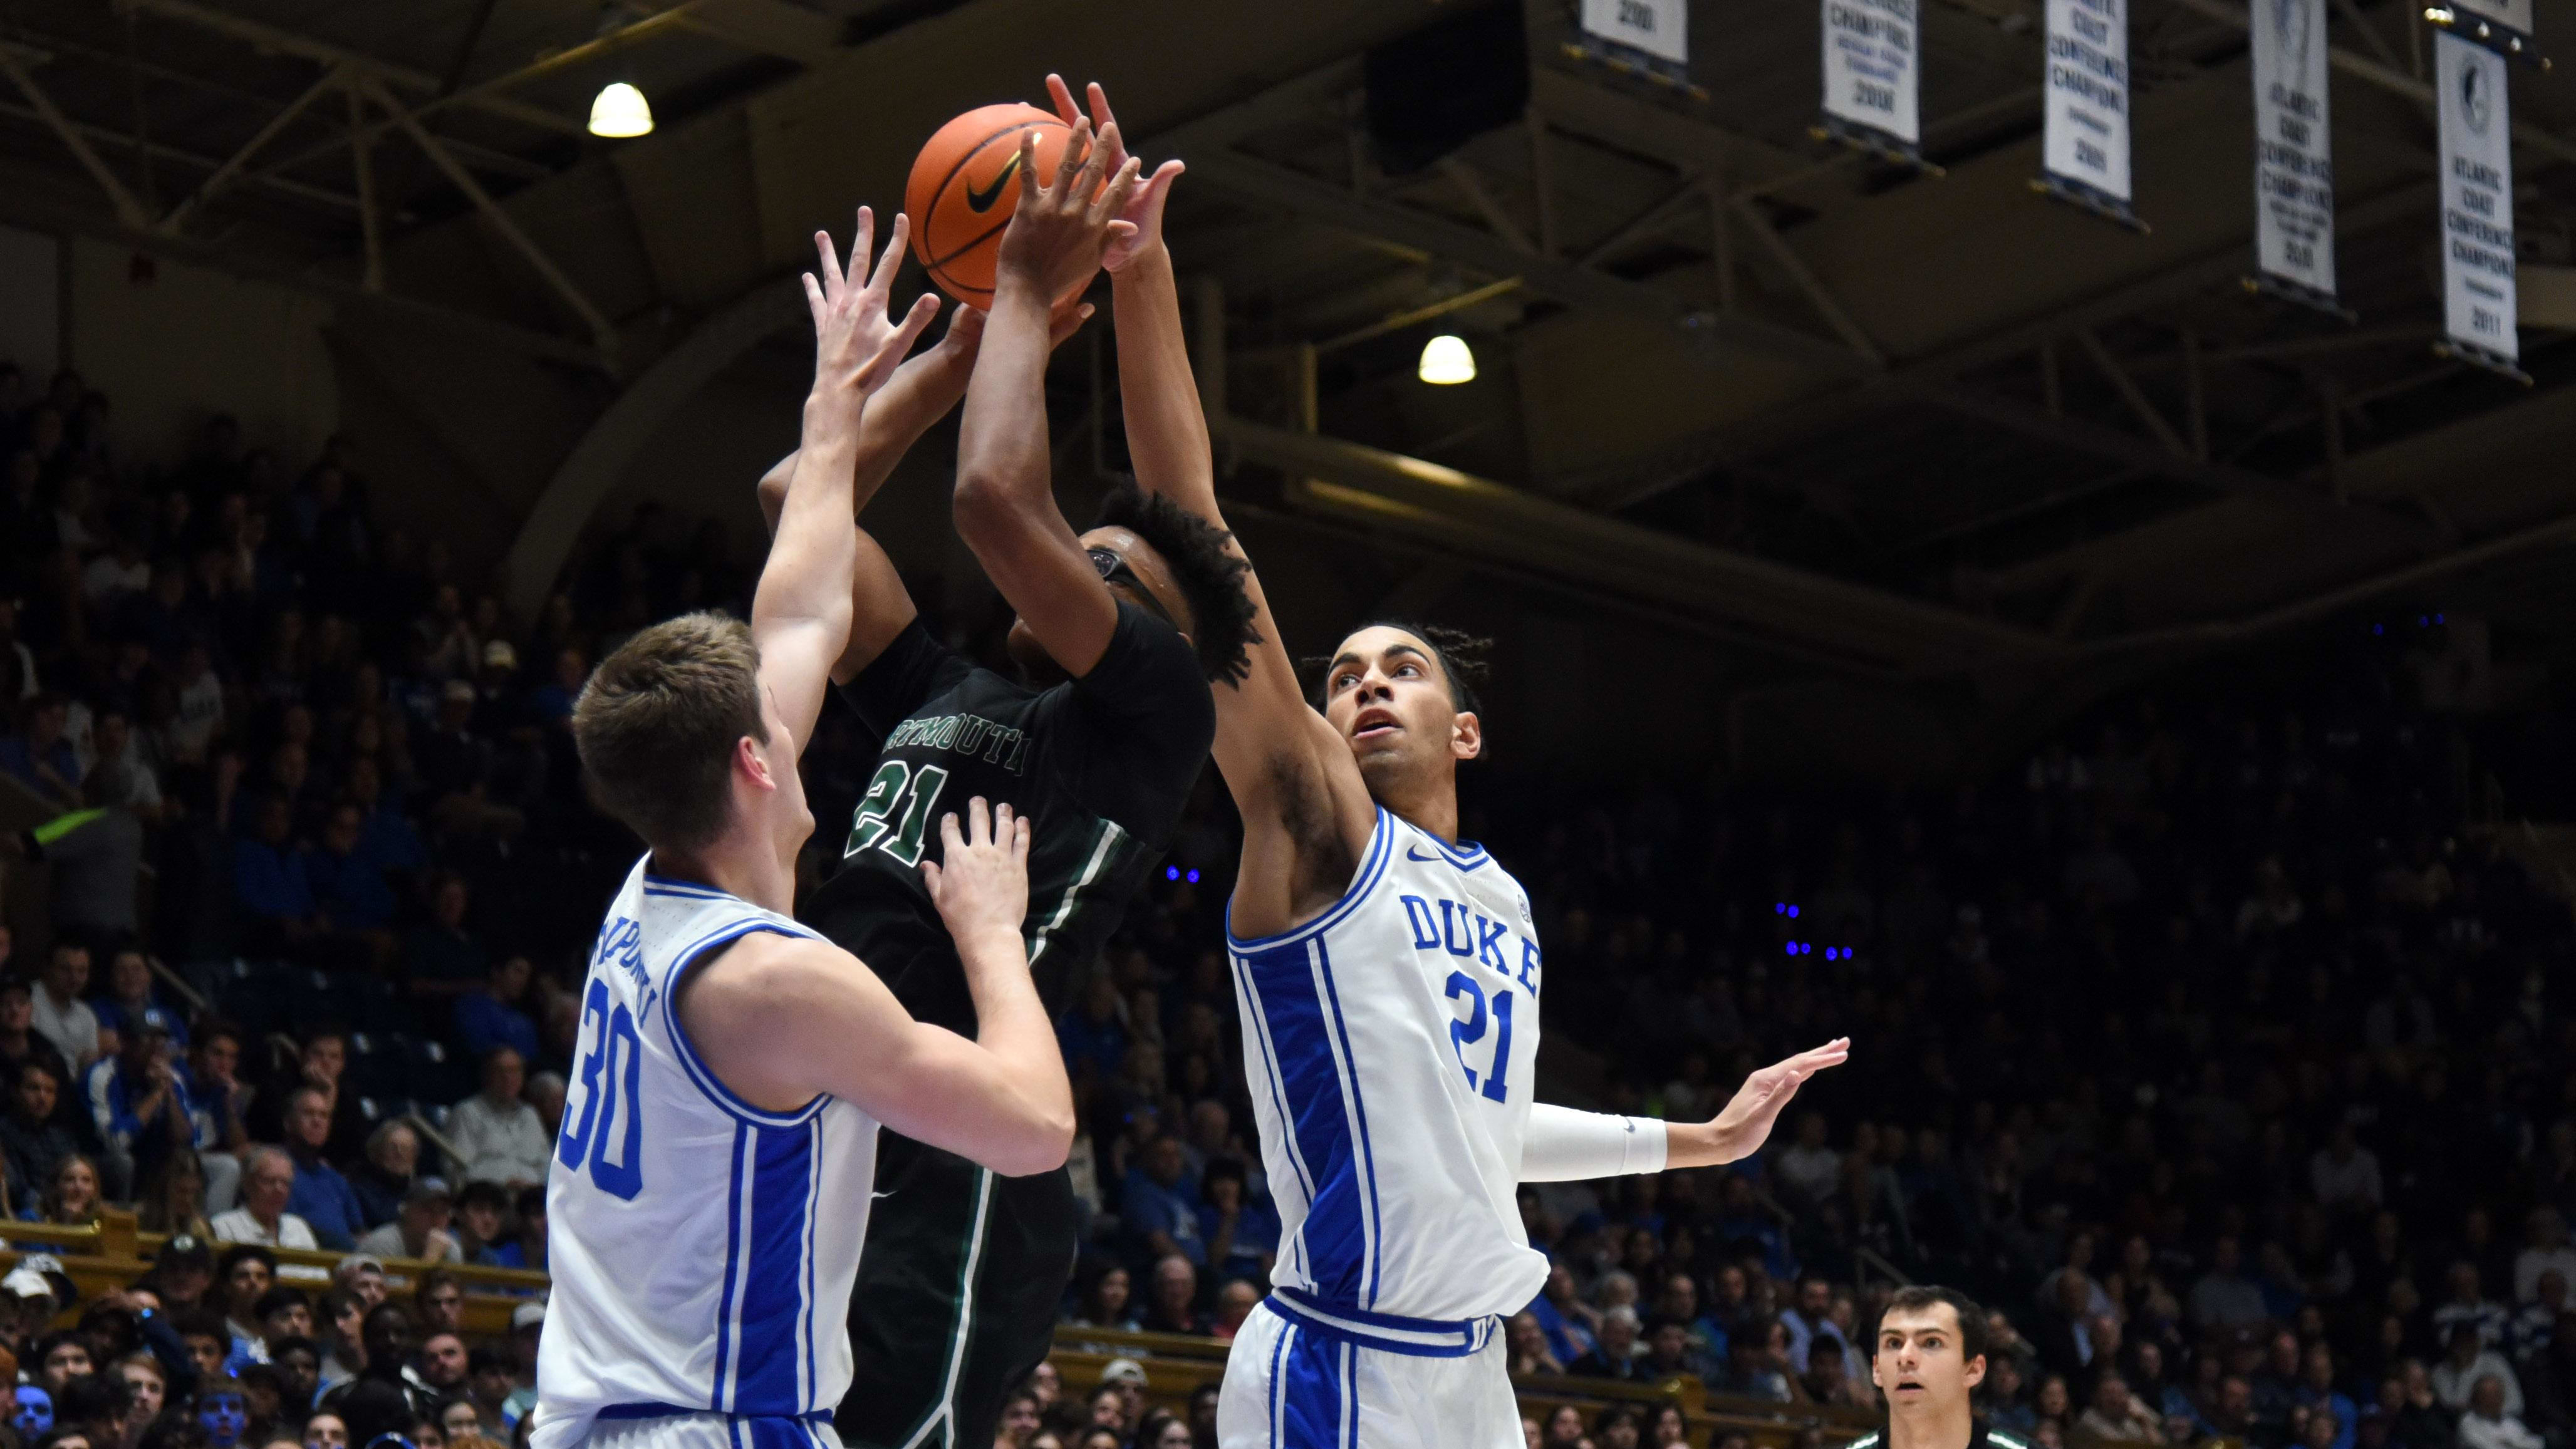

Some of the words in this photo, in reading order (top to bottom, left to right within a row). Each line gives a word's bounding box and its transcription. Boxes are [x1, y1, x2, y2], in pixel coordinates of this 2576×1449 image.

[2472, 306, 2501, 338] 2011
[844, 760, 948, 868] 21
[1400, 895, 1542, 999] DUKE
[559, 977, 643, 1202] 30
[1444, 970, 1514, 1104] 21
